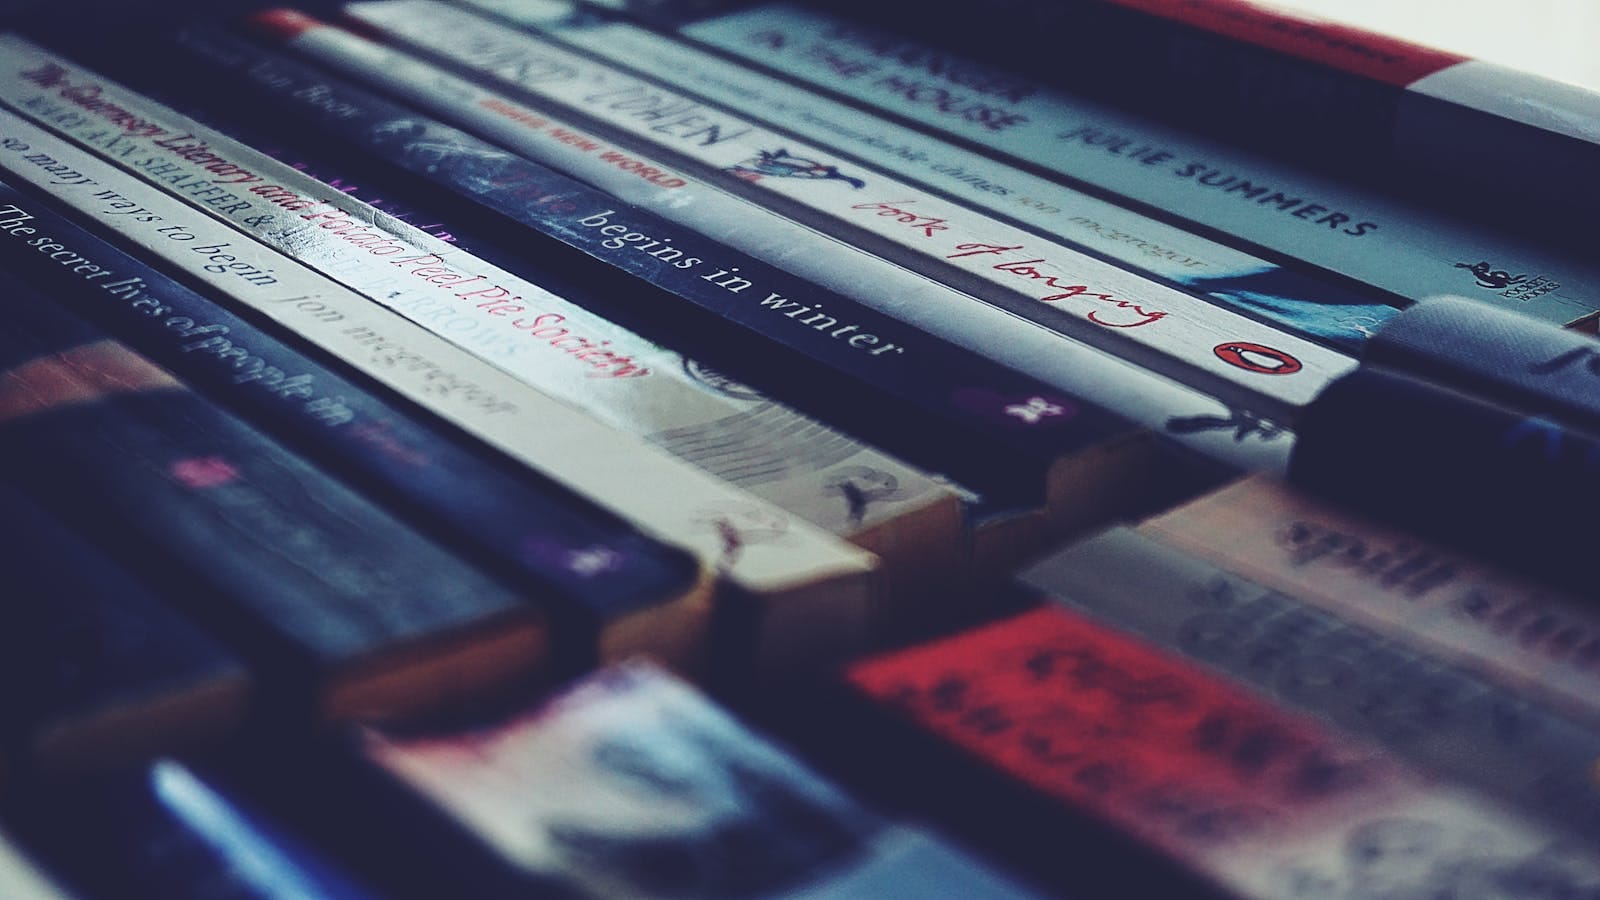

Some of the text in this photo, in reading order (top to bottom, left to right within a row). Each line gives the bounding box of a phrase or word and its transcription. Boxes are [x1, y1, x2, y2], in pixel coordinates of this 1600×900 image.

[547, 126, 601, 153] NEW
[597, 149, 688, 189] WORLD
[872, 74, 1031, 132] HOUSE
[1, 136, 31, 151] so
[23, 152, 99, 186] many
[92, 189, 164, 224] ways
[156, 223, 197, 242] to
[191, 242, 280, 288] begin
[272, 293, 346, 323] jon
[134, 156, 254, 217] SHAFFER
[243, 214, 276, 229] &
[929, 160, 1014, 198] things
[1066, 212, 1208, 269] mcgregor
[1056, 124, 1379, 238] JULIE SUMMERS
[0, 203, 36, 238] The
[26, 235, 112, 280] secret
[99, 276, 173, 318] lives
[152, 131, 265, 184] Literary
[248, 184, 332, 213] and
[299, 205, 407, 257] Potato
[389, 250, 490, 290] Peel
[453, 283, 528, 317] Pie
[511, 311, 653, 379] Society
[576, 208, 704, 272] begins
[699, 265, 753, 295] in
[758, 290, 906, 357] winter
[851, 199, 951, 237] book
[992, 258, 1169, 329] longing
[1497, 273, 1551, 299] POCKET
[1516, 281, 1562, 303] BOOKS
